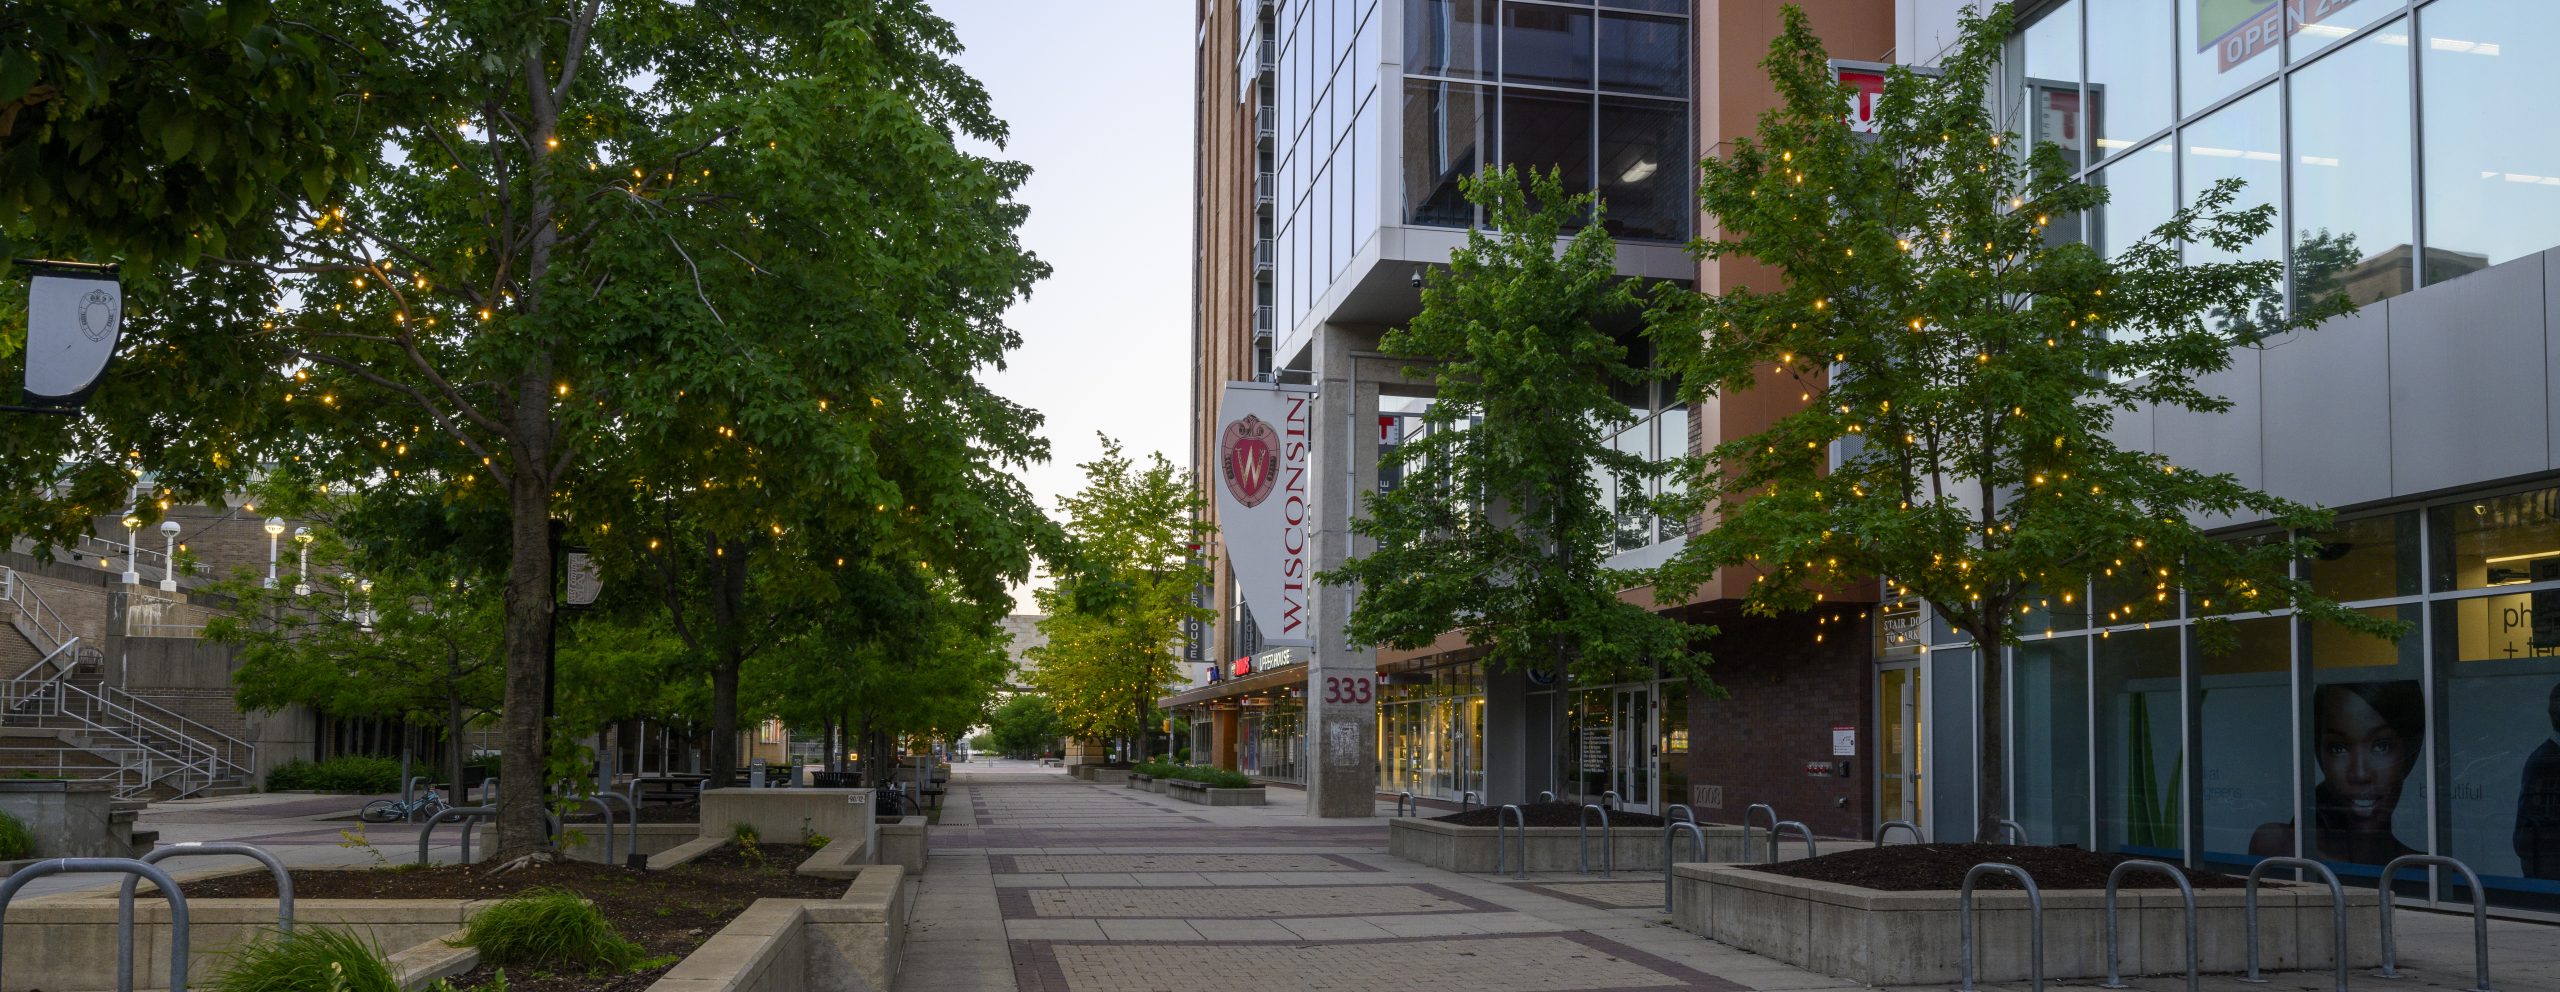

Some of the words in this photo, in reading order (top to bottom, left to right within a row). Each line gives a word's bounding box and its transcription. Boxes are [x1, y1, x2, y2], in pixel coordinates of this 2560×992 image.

[2226, 1, 2305, 63] OPEN
[1283, 394, 1306, 635] WISCONSIN
[1884, 618, 1906, 631] STAIR
[1910, 615, 1920, 627] DO
[2503, 602, 2532, 633] ph
[1885, 632, 1896, 643] TO
[1260, 653, 1274, 672] UPPER
[1273, 649, 1290, 669] HOUSE
[1325, 676, 1373, 704] 333
[1696, 786, 1721, 805] 2008
[2419, 783, 2483, 800] butiful
